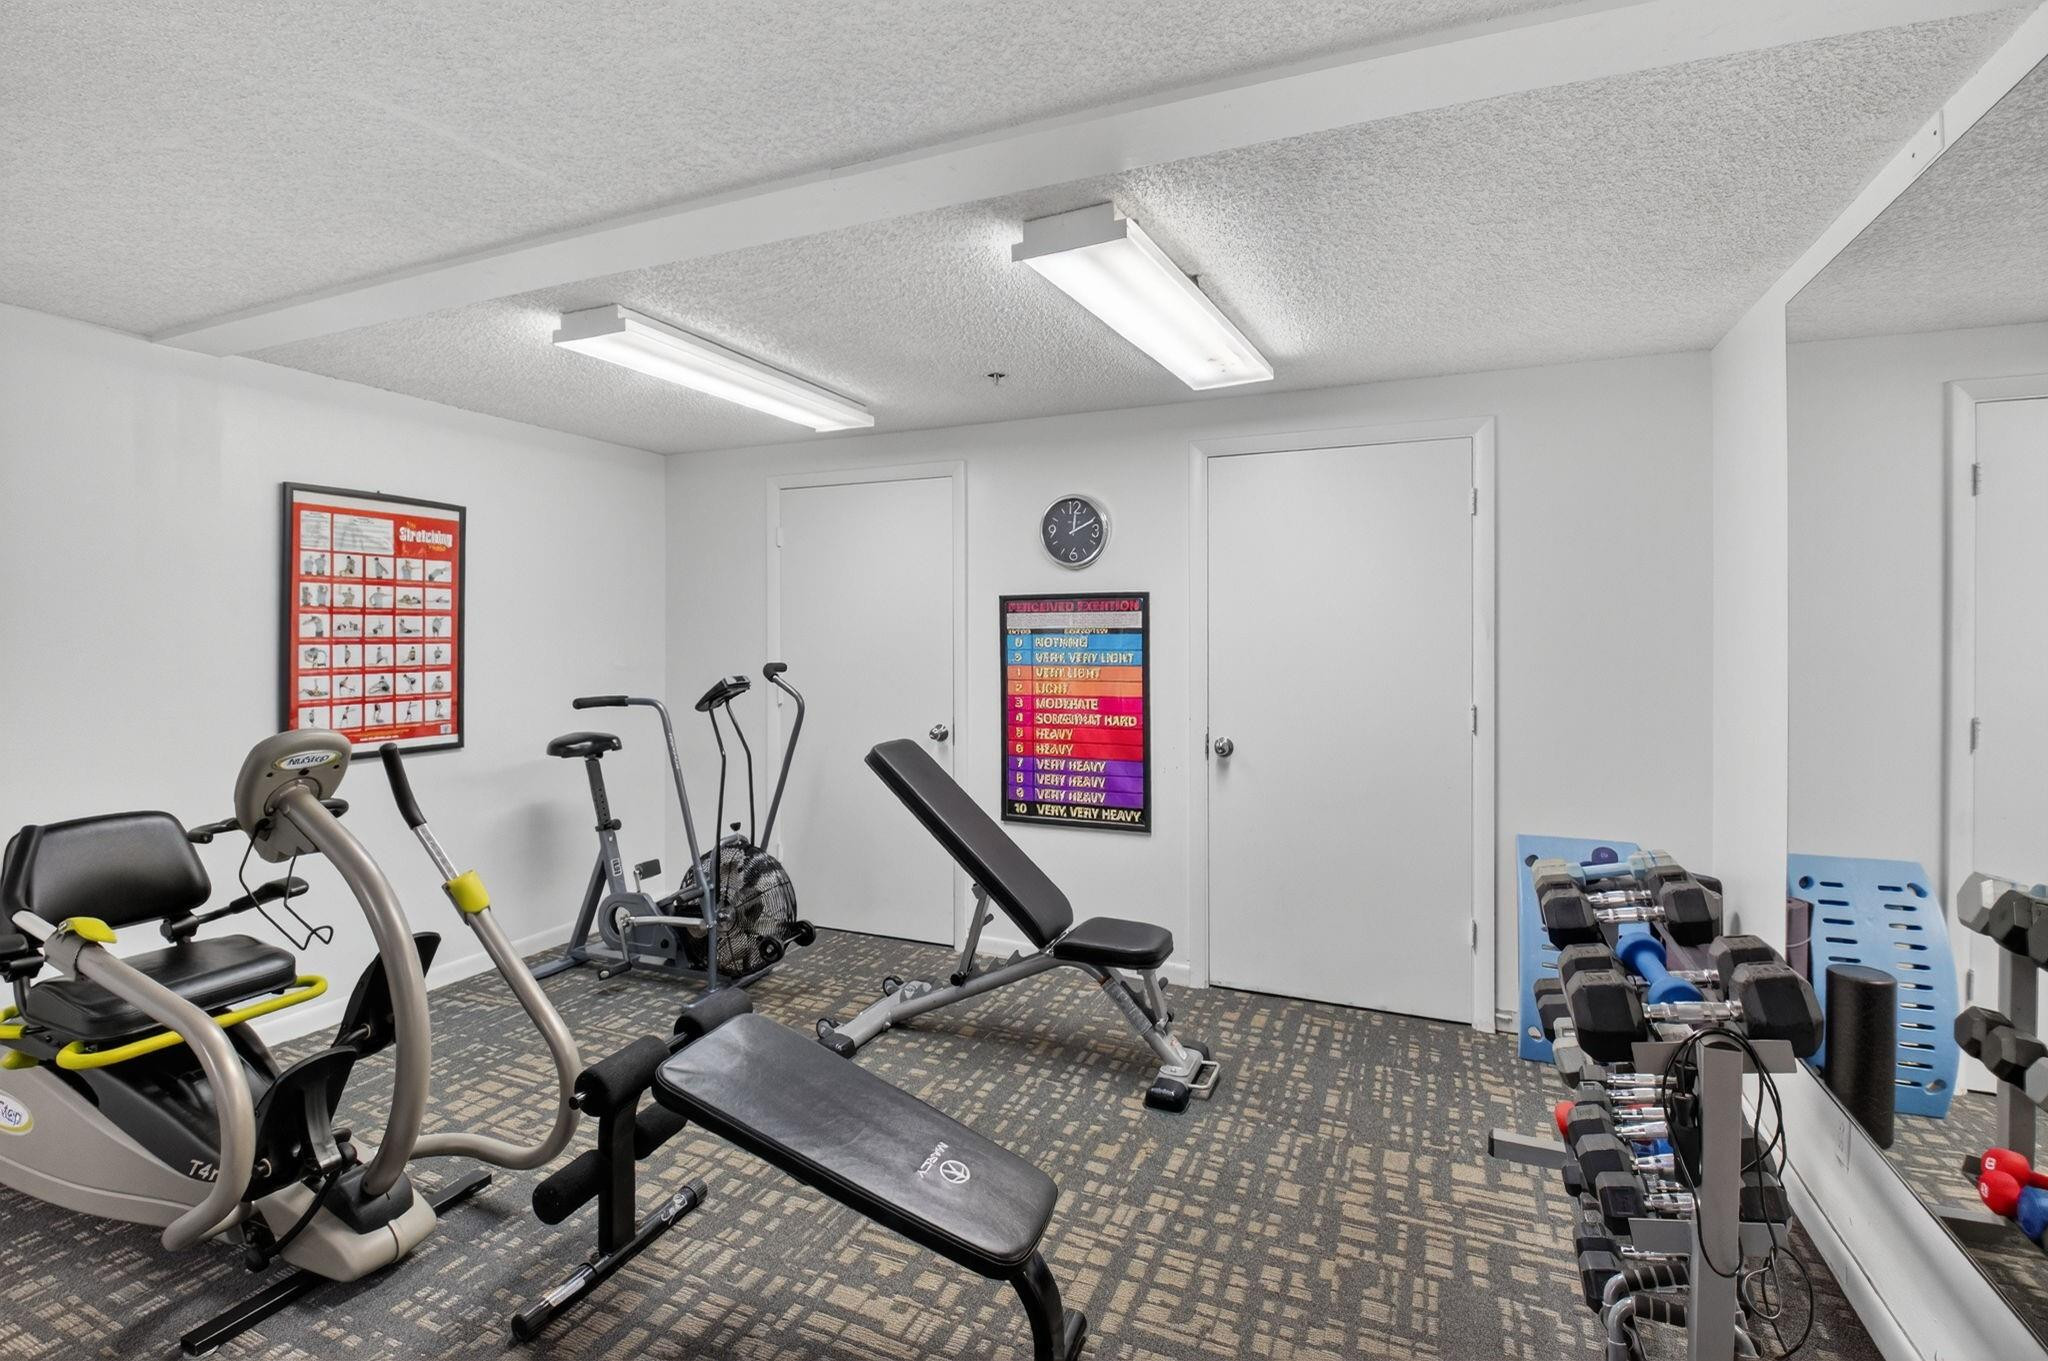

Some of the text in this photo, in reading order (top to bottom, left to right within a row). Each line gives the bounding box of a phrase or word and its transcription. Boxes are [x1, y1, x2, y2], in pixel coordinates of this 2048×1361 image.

[1068, 501, 1082, 515] 12
[1048, 524, 1057, 539] 9
[1091, 523, 1100, 538] 3
[1069, 547, 1078, 561] 6
[1035, 637, 1088, 648] NOTHING
[1069, 652, 1097, 663] VERY
[1101, 653, 1134, 663] LIGHT
[1067, 667, 1100, 679] LIGHT
[1035, 682, 1069, 694] LIGHT
[1014, 697, 1098, 710] 3 MODERATE
[1035, 713, 1101, 726] SOMEWHAT
[1104, 715, 1137, 727] HARD
[1035, 728, 1074, 740] HEAVY
[1035, 743, 1074, 755] HEAVY
[1016, 757, 1106, 773] 7 VERY HEAVY
[1036, 773, 1066, 786] VERY
[1069, 775, 1106, 788] HEAVY
[1036, 788, 1066, 800] VERY
[1069, 790, 1106, 803] HEAVY
[1014, 803, 1027, 814] 10
[1070, 806, 1100, 819] VERY
[1102, 809, 1142, 822] HEAVY
[917, 1141, 949, 1179] MARCY
